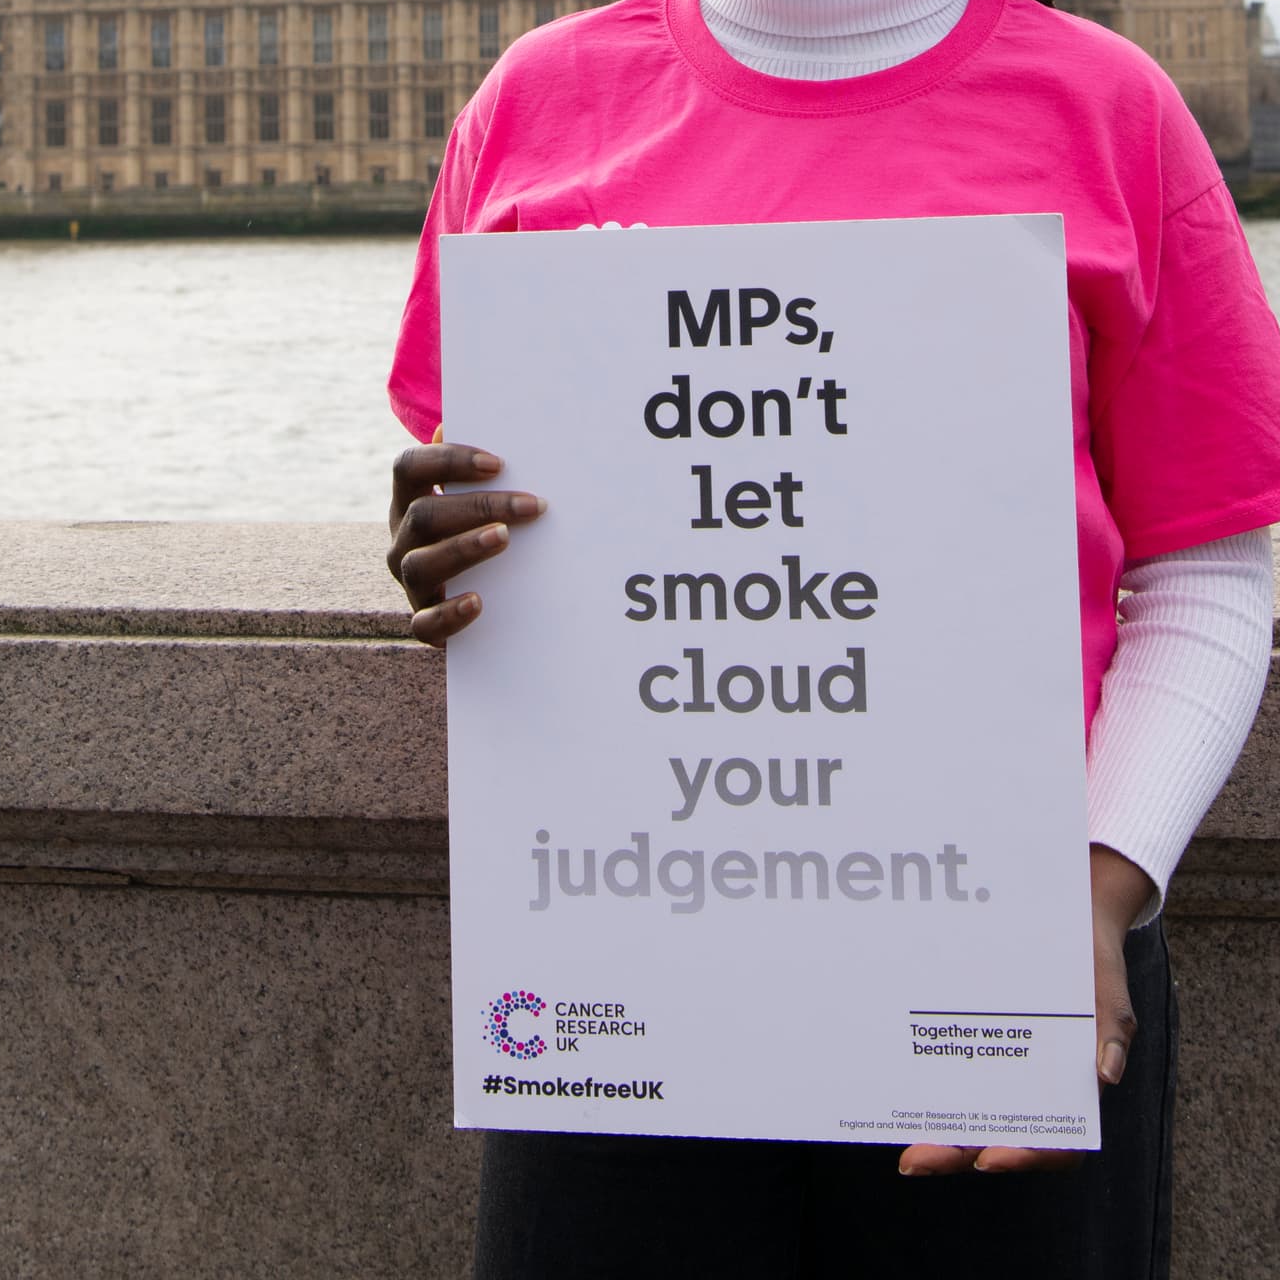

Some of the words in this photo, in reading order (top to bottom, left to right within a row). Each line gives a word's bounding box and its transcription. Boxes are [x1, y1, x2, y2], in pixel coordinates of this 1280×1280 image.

[667, 287, 835, 354] MPs,
[643, 374, 848, 440] don't
[690, 464, 804, 530] let
[624, 554, 879, 622] smoke
[638, 647, 868, 714] cloud
[668, 757, 843, 822] your
[529, 828, 991, 915] judgement.
[555, 1002, 625, 1018] CANCER
[556, 1020, 646, 1037] RESEARCH
[910, 1023, 978, 1041] Together
[981, 1027, 1004, 1039] we
[1006, 1028, 1033, 1040] are
[556, 1037, 580, 1052] UK
[912, 1041, 974, 1059] beating
[976, 1045, 1030, 1058] cancer
[482, 1074, 665, 1100] #SmokefreeUK
[839, 1120, 875, 1130] England
[876, 1120, 894, 1129] and
[895, 1121, 922, 1130] Wales
[924, 1120, 967, 1132] (1089464)
[968, 1123, 987, 1132] and
[988, 1123, 1028, 1133] Scotland
[891, 1110, 924, 1119] Cancer
[925, 1111, 967, 1121] Research
[968, 1112, 980, 1121] UK
[981, 1112, 989, 1121] is
[998, 1113, 1044, 1124] registered
[1045, 1114, 1076, 1125] charity
[1078, 1114, 1086, 1123] in
